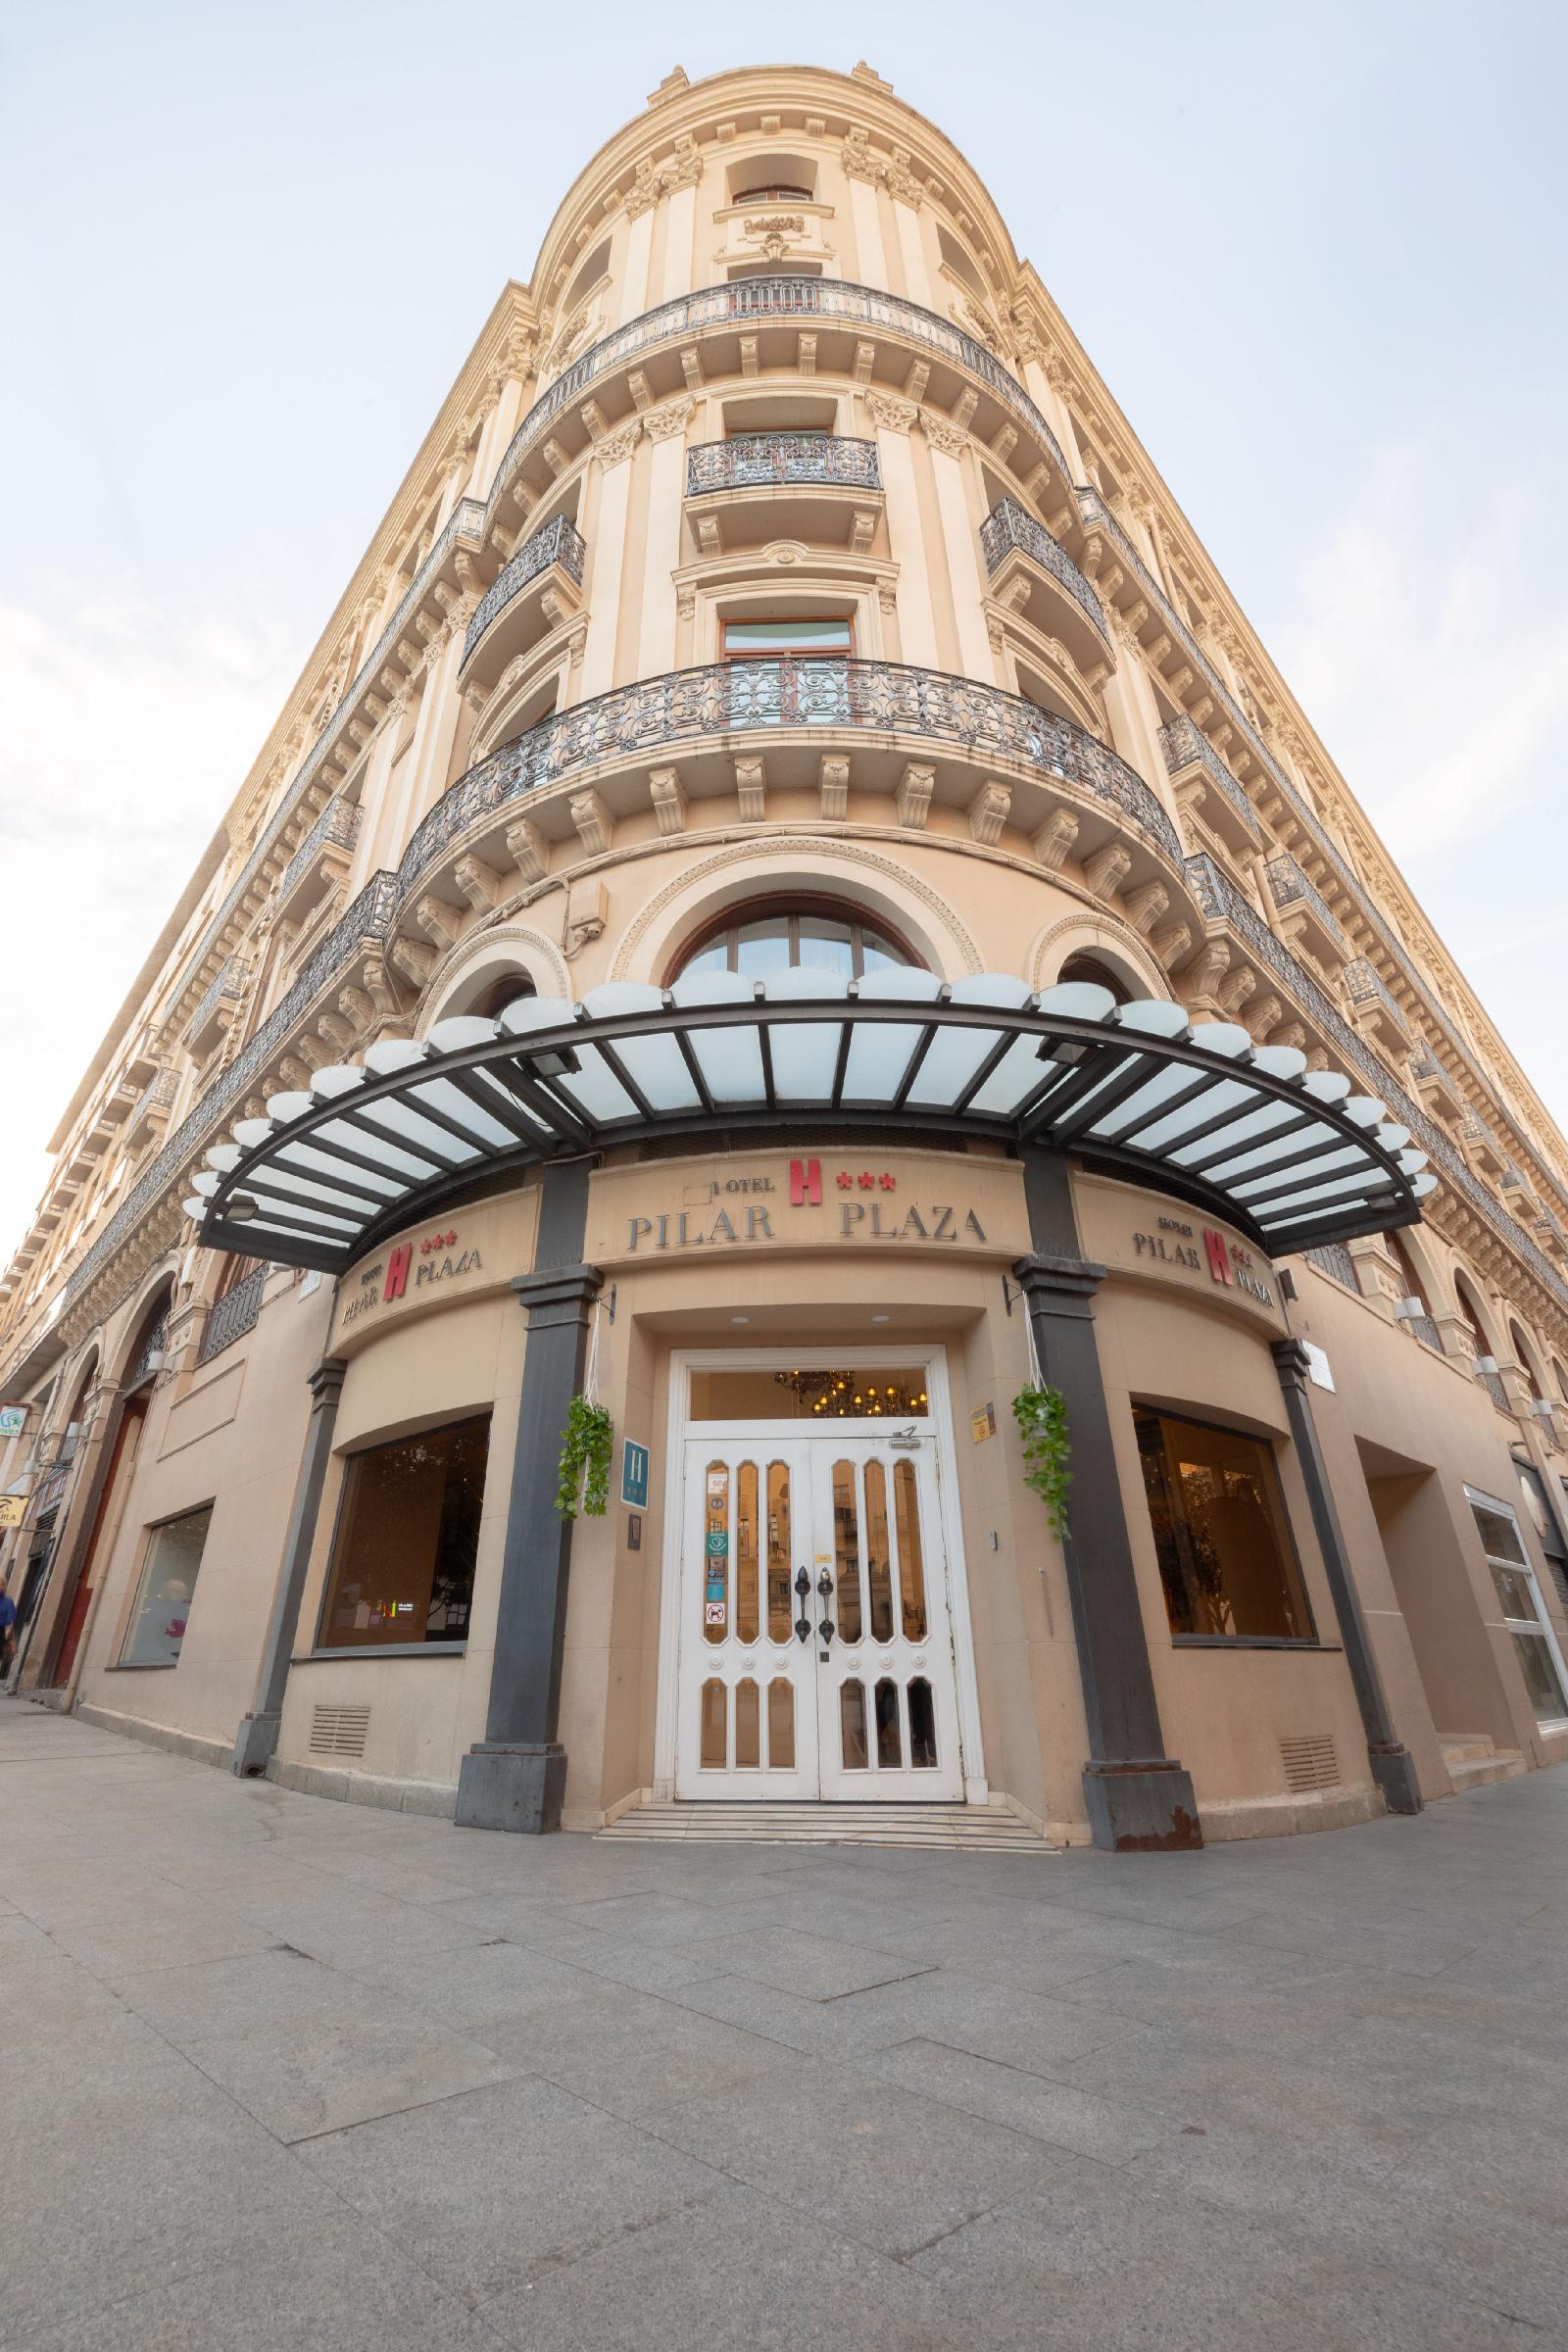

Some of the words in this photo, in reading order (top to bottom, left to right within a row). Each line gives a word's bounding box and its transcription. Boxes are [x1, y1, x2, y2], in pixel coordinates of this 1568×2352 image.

[627, 1205, 775, 1251] PILAR
[838, 1202, 988, 1241] PLAZA
[415, 1248, 482, 1287] PLAZA
[1133, 1232, 1201, 1271] PILAR
[630, 1449, 643, 1484] H
